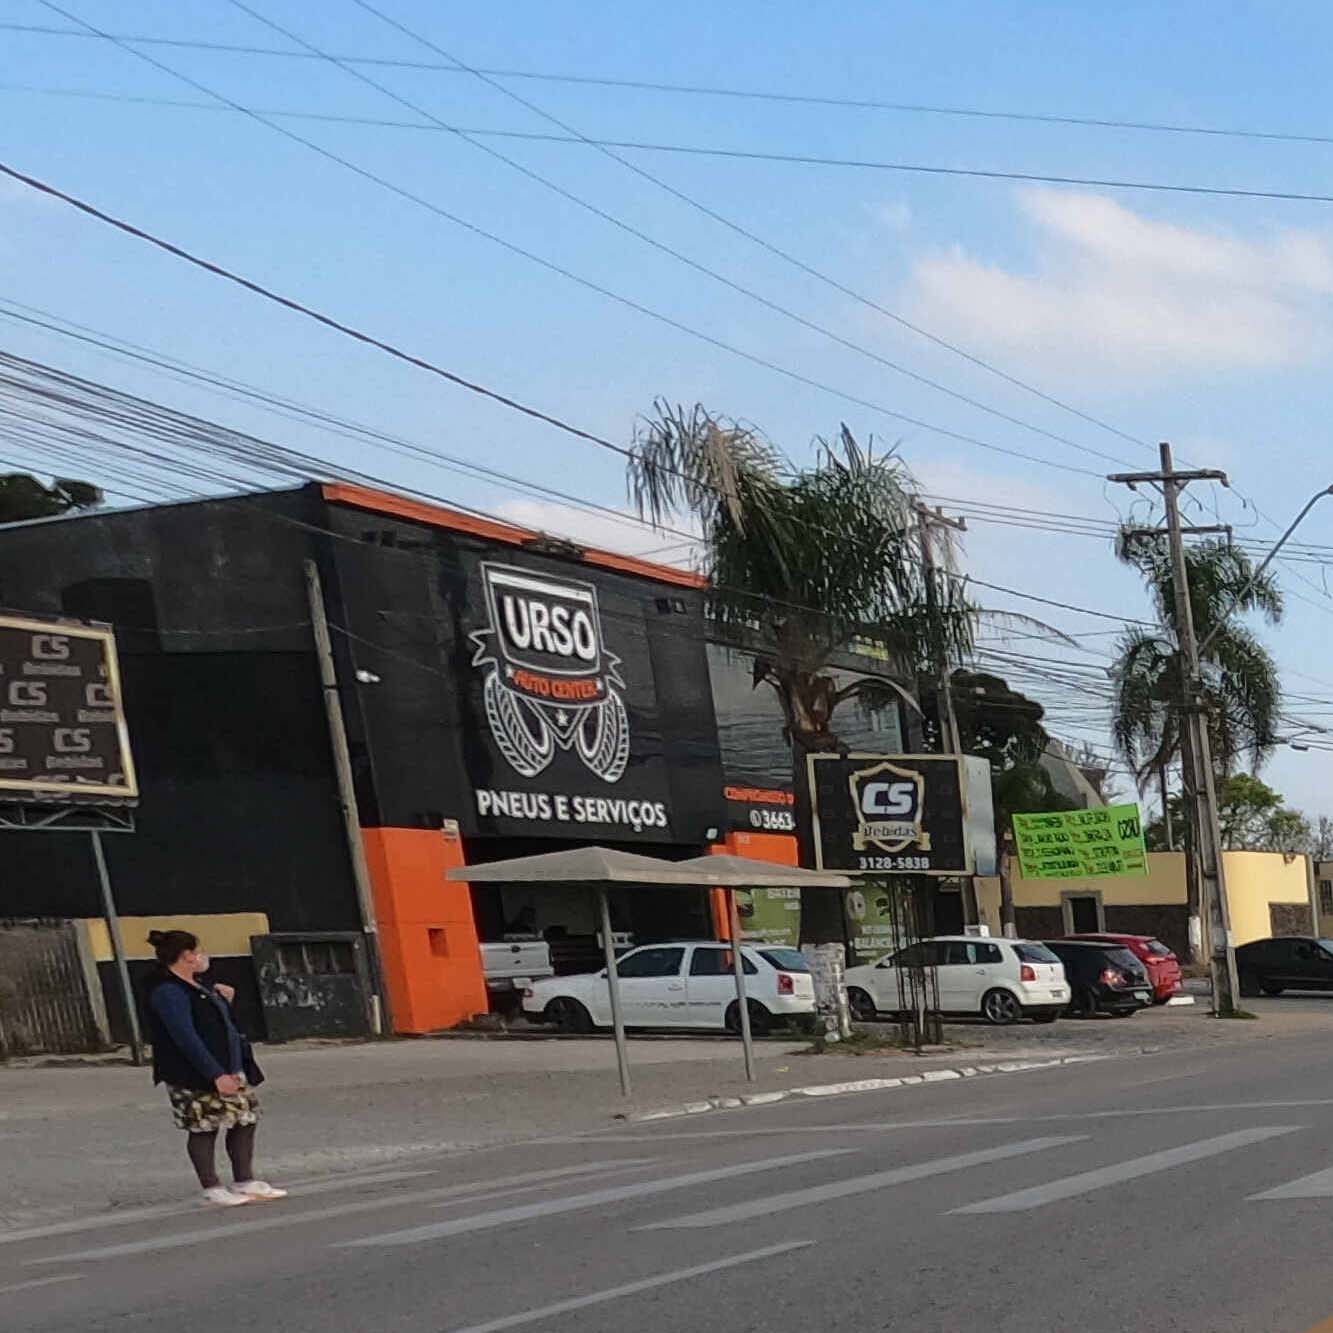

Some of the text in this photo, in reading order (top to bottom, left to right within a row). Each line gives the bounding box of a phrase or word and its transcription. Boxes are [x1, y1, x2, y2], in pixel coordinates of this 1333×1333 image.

[504, 595, 597, 661] URSO
[31, 634, 70, 660] CS
[8, 681, 48, 706] CS
[512, 670, 598, 699] AUTO CENTER
[53, 728, 91, 753] CS
[476, 789, 668, 832] PNEUS E SERVIÇOS
[861, 781, 915, 815] CS
[858, 856, 930, 870] 3128-5838
